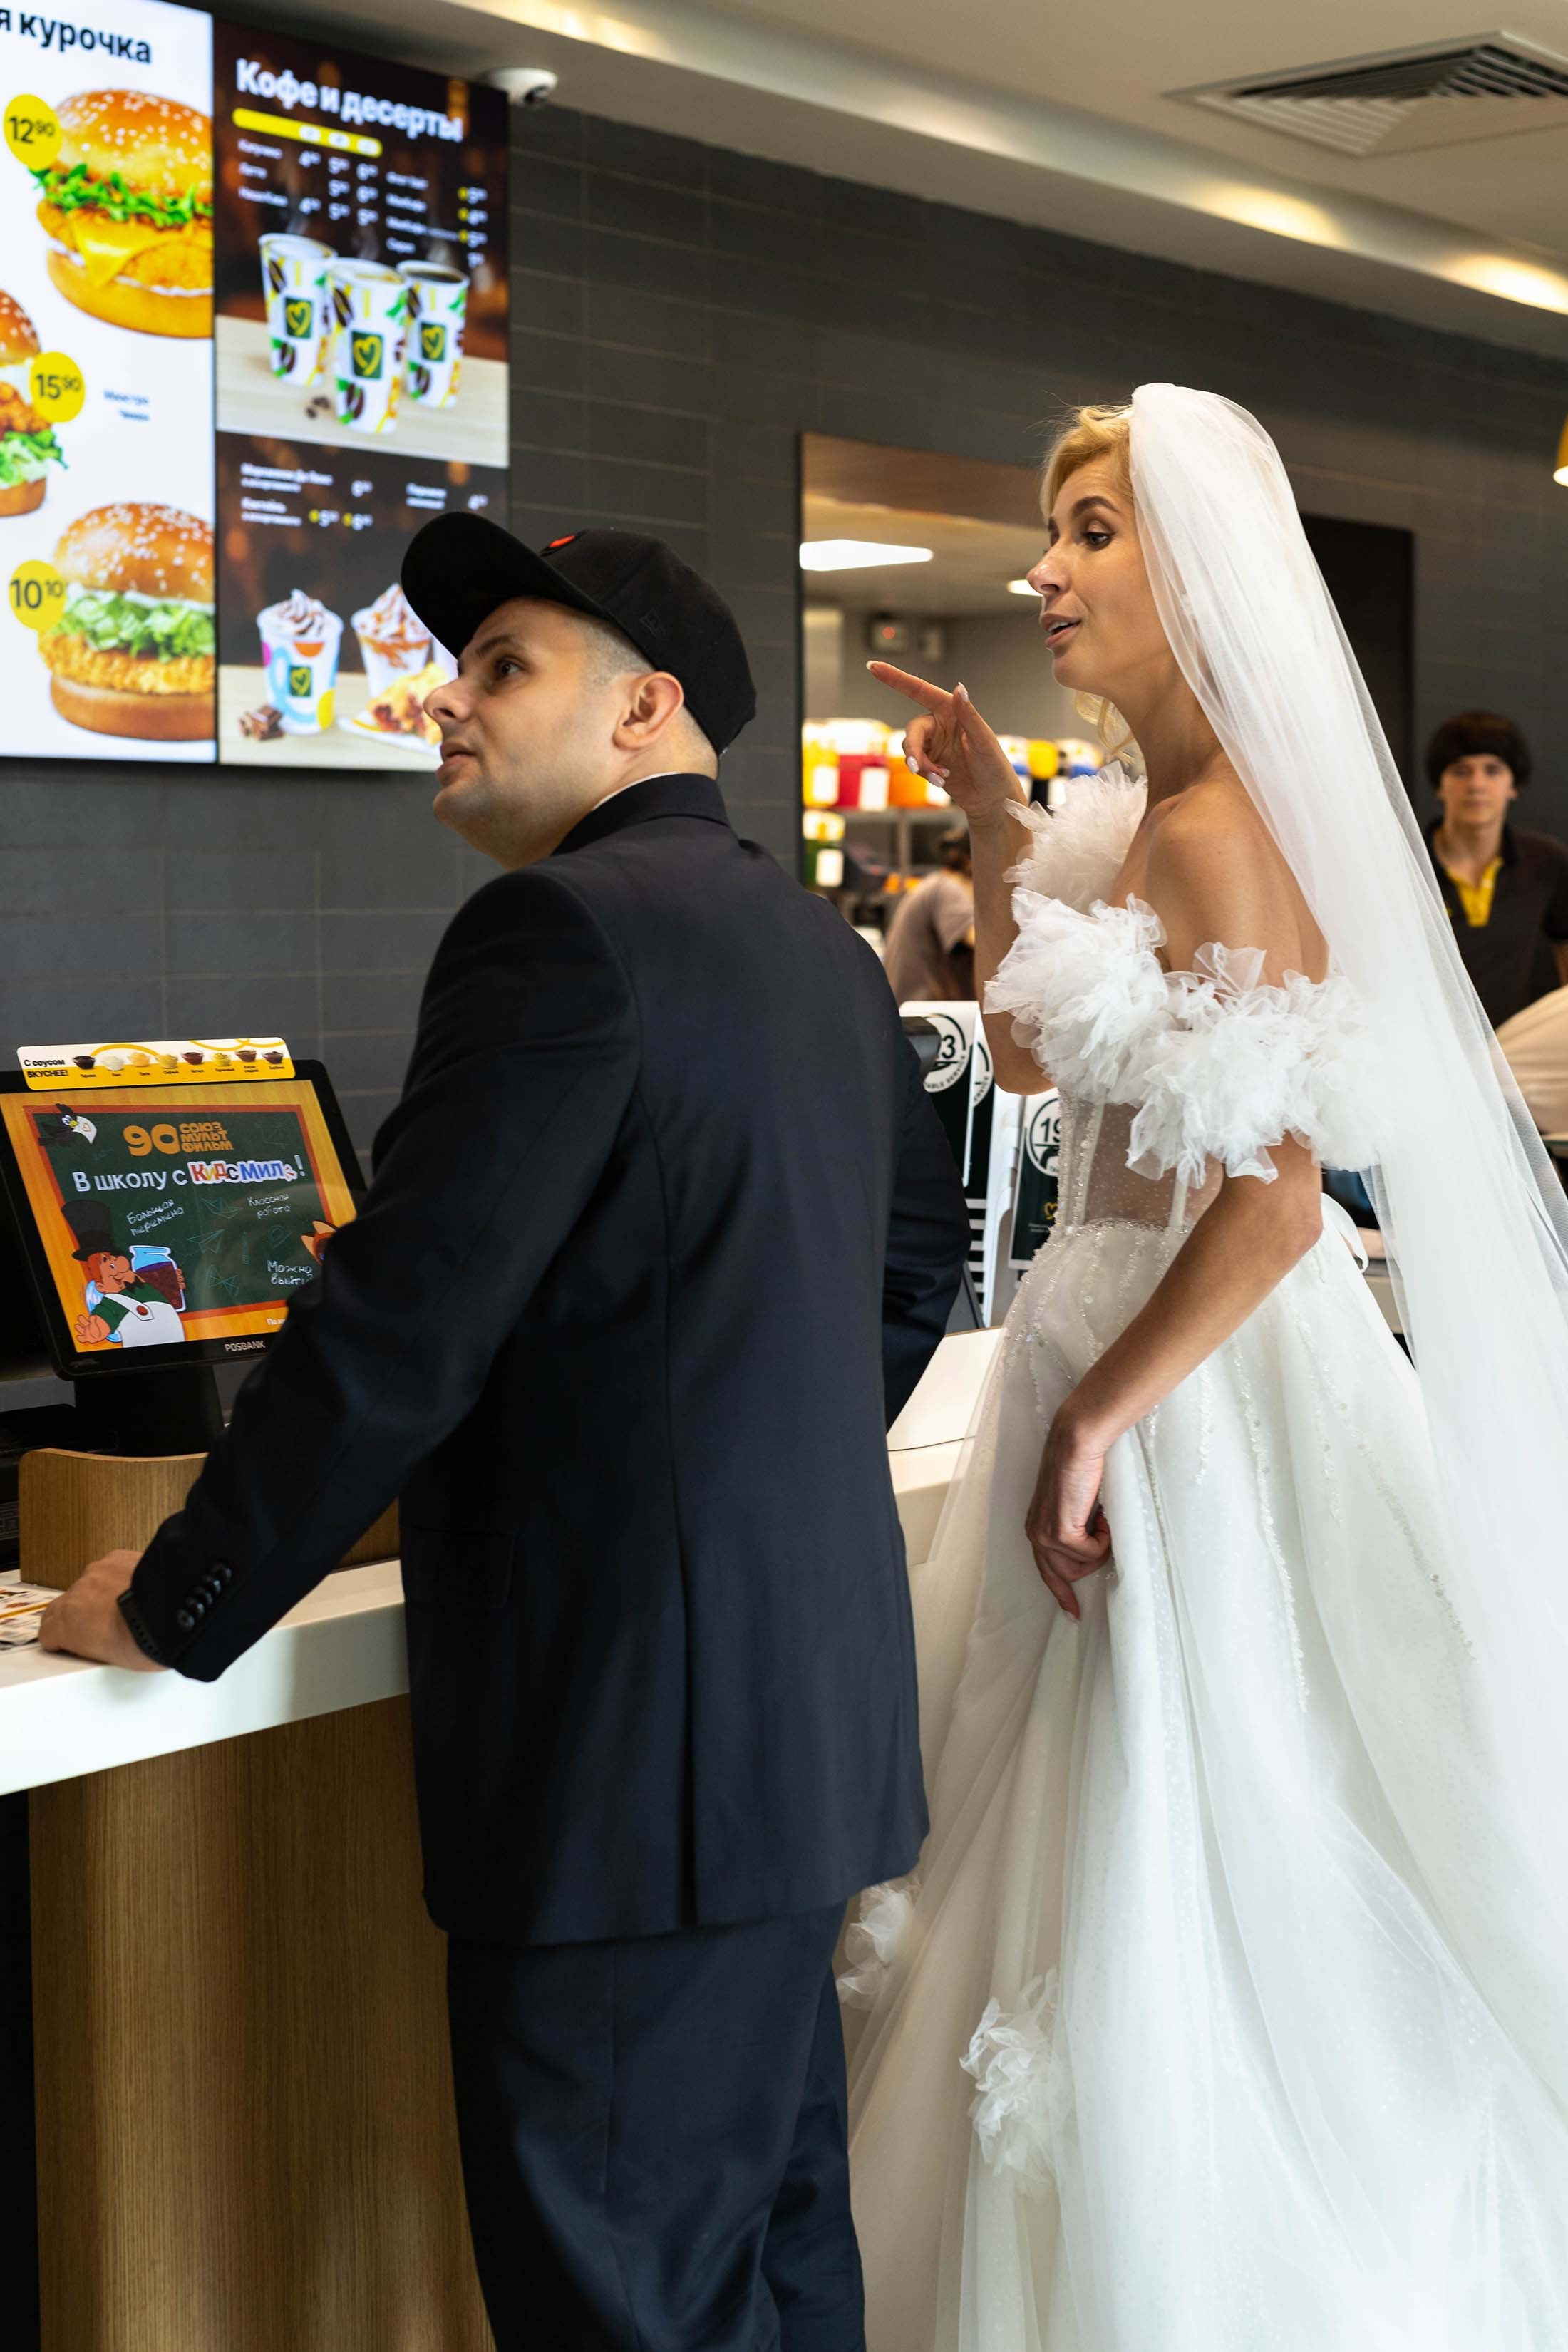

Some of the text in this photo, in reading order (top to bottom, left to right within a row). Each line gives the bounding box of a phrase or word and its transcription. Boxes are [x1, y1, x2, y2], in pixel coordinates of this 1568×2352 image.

[20, 12, 150, 63] курочка
[236, 58, 319, 110] Кофе
[319, 85, 341, 114] и
[341, 91, 464, 143] десерты
[939, 1034, 956, 1059] 3
[179, 1121, 222, 1134] СОЮЗ
[180, 1130, 228, 1142] МУЛЬТ
[123, 1123, 180, 1156] 90
[182, 1140, 234, 1152] ФИЛЬМ
[73, 1171, 91, 1192] В
[95, 1170, 167, 1190] школу
[172, 1170, 188, 1185] с
[225, 1341, 266, 1352] POSBANK
